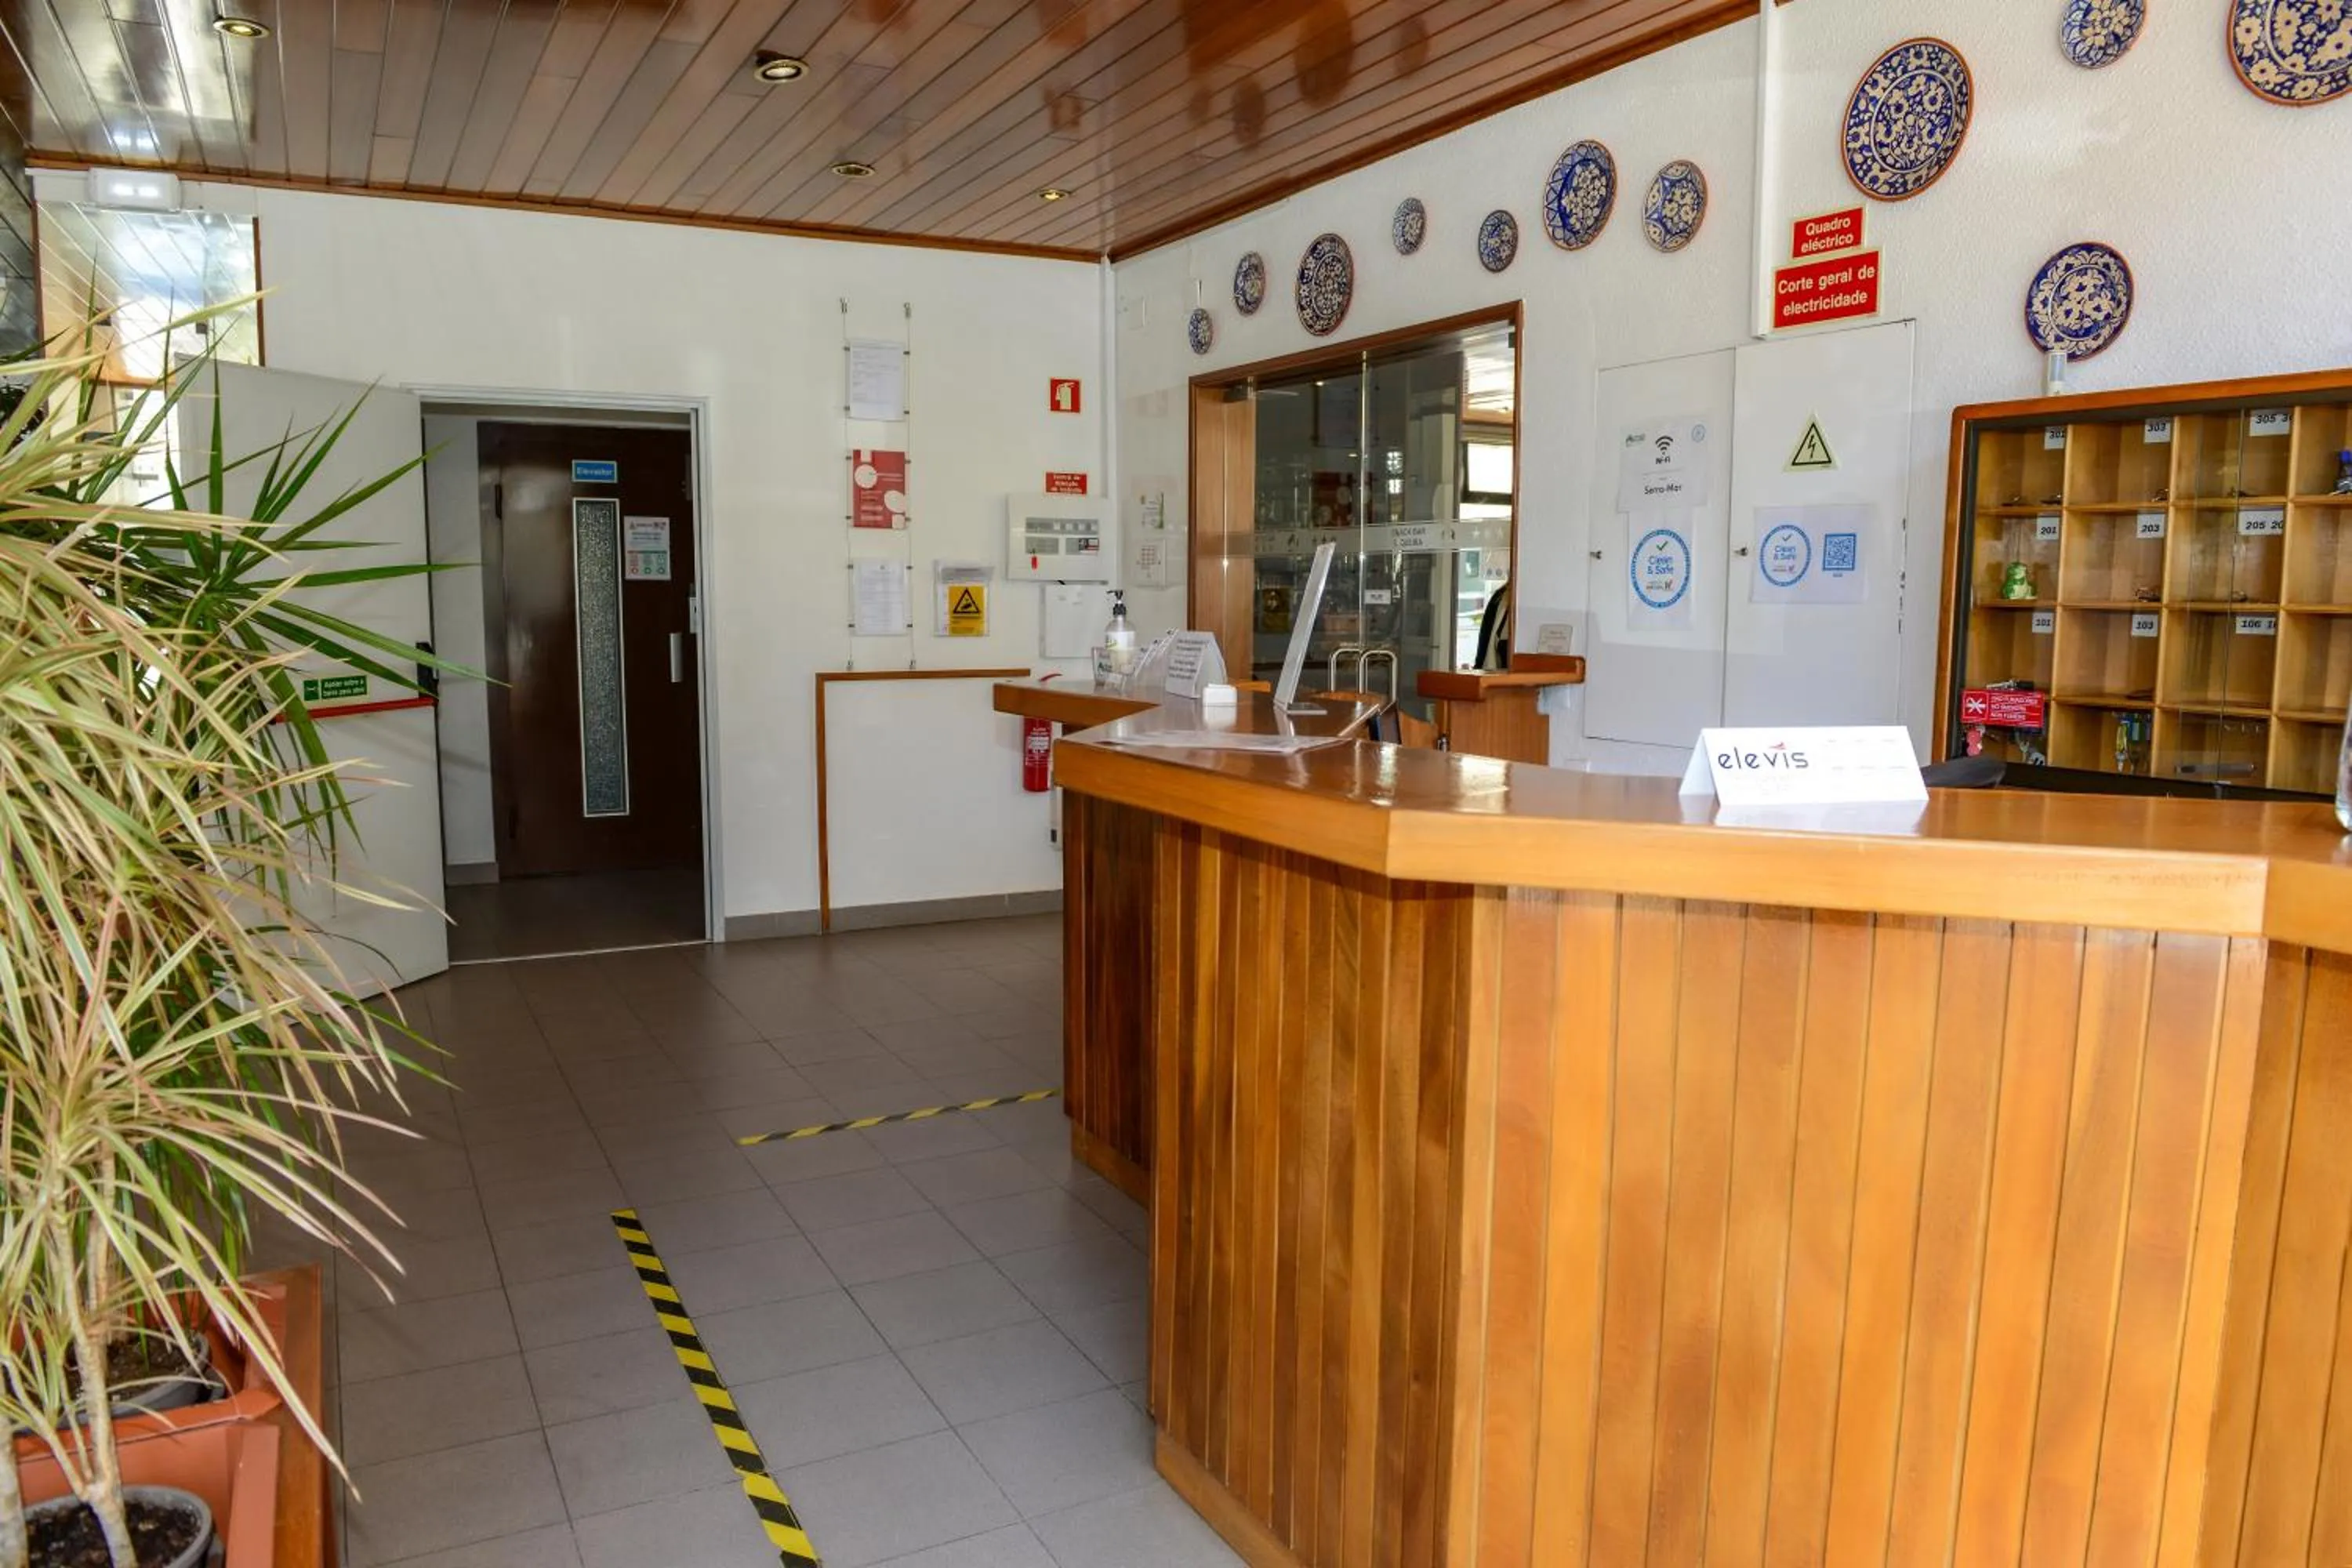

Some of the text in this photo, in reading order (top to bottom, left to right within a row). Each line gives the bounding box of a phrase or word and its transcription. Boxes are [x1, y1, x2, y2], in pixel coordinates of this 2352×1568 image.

[1806, 217, 1851, 236] Quadro
[1801, 234, 1854, 253] eléctrico
[1778, 264, 1875, 295] Corte geral de
[1783, 290, 1868, 317] electricidade
[2256, 414, 2276, 424] 305
[2147, 423, 2166, 433] 303
[2040, 526, 2056, 535] 201
[2141, 524, 2160, 533] 203
[2245, 521, 2265, 531] 205
[1648, 555, 1673, 564] Clean
[1656, 564, 1674, 575] Safe
[2136, 621, 2154, 630] 103
[1717, 746, 1809, 769] elevis
